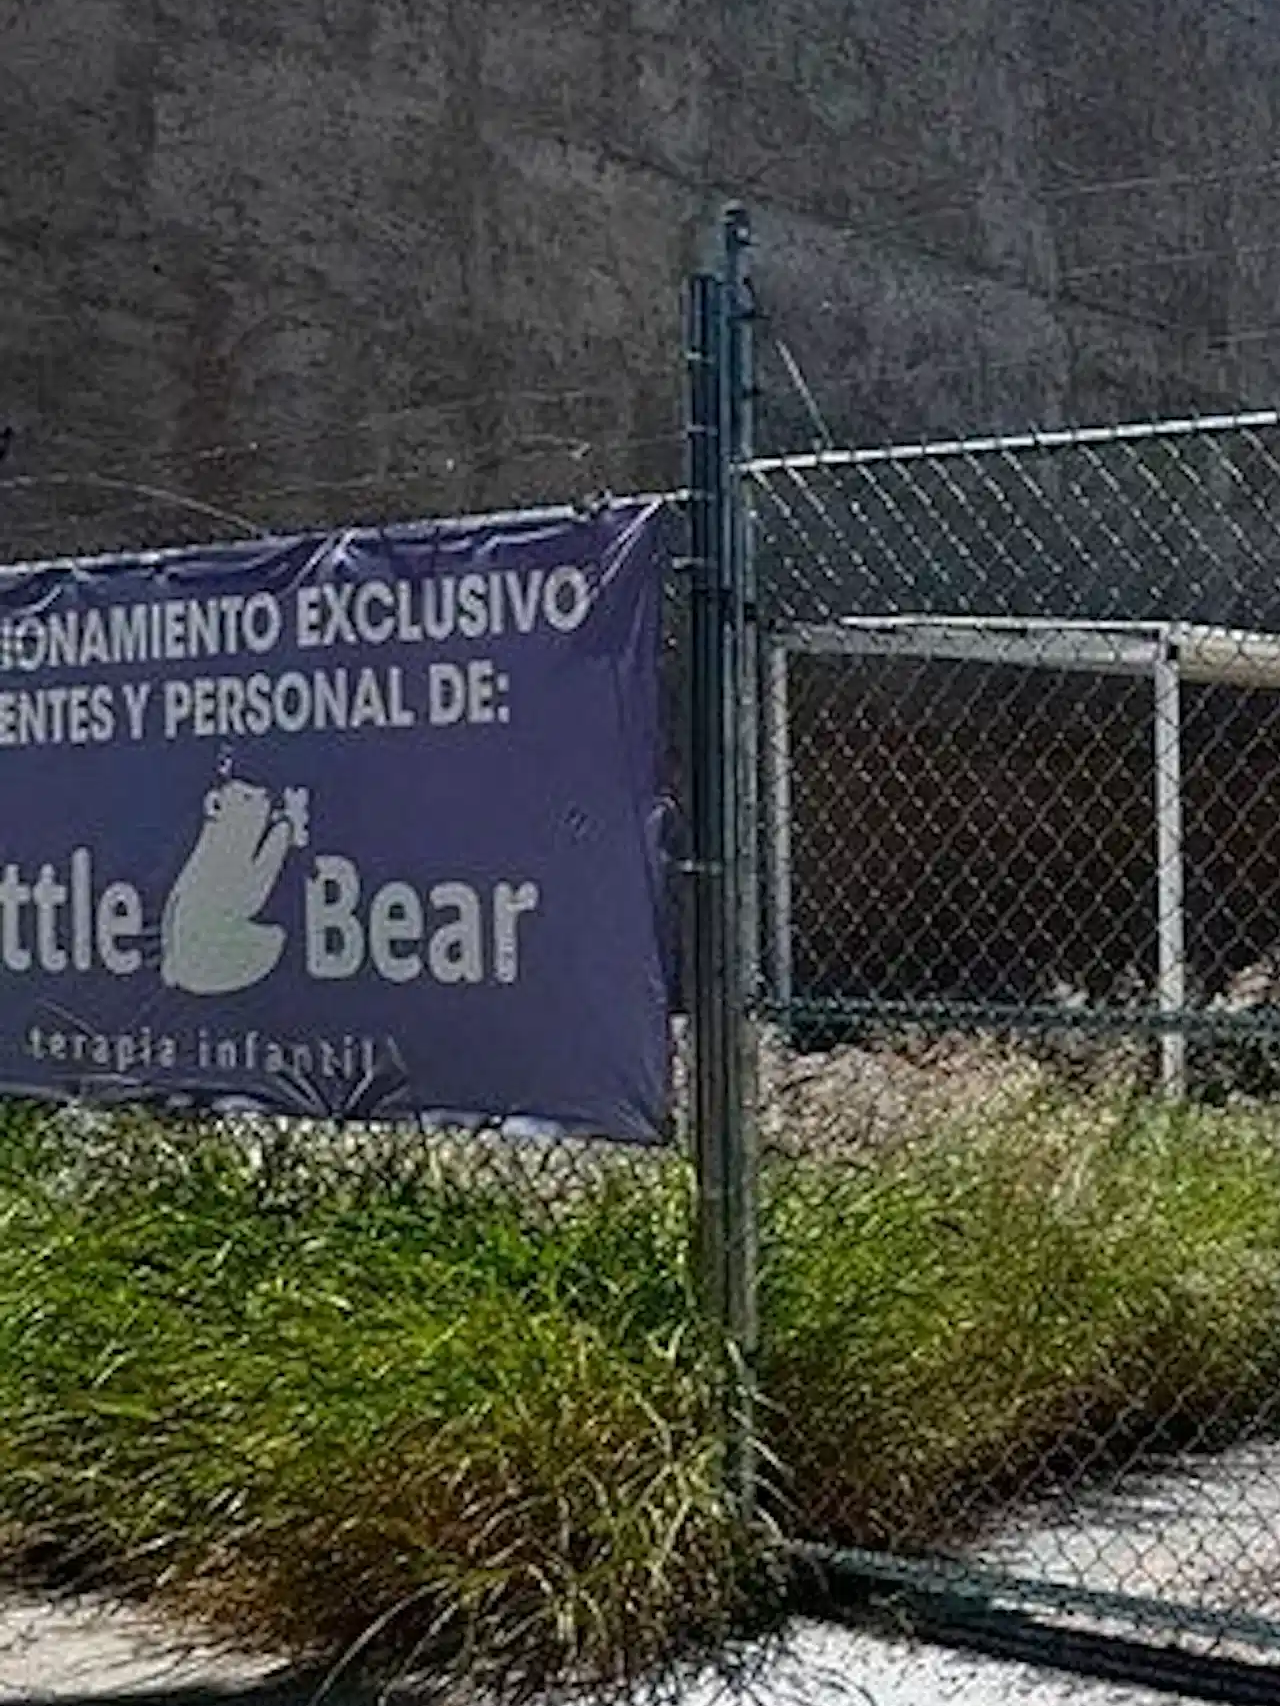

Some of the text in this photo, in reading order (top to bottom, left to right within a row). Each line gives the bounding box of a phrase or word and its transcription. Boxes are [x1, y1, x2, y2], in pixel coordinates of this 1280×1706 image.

[297, 564, 592, 647] EXCLUSIVO
[0, 659, 510, 744] ENTES Y PERSONAL DE:
[0, 846, 539, 984] ttle Bear
[27, 1025, 377, 1079] terapia infantil
